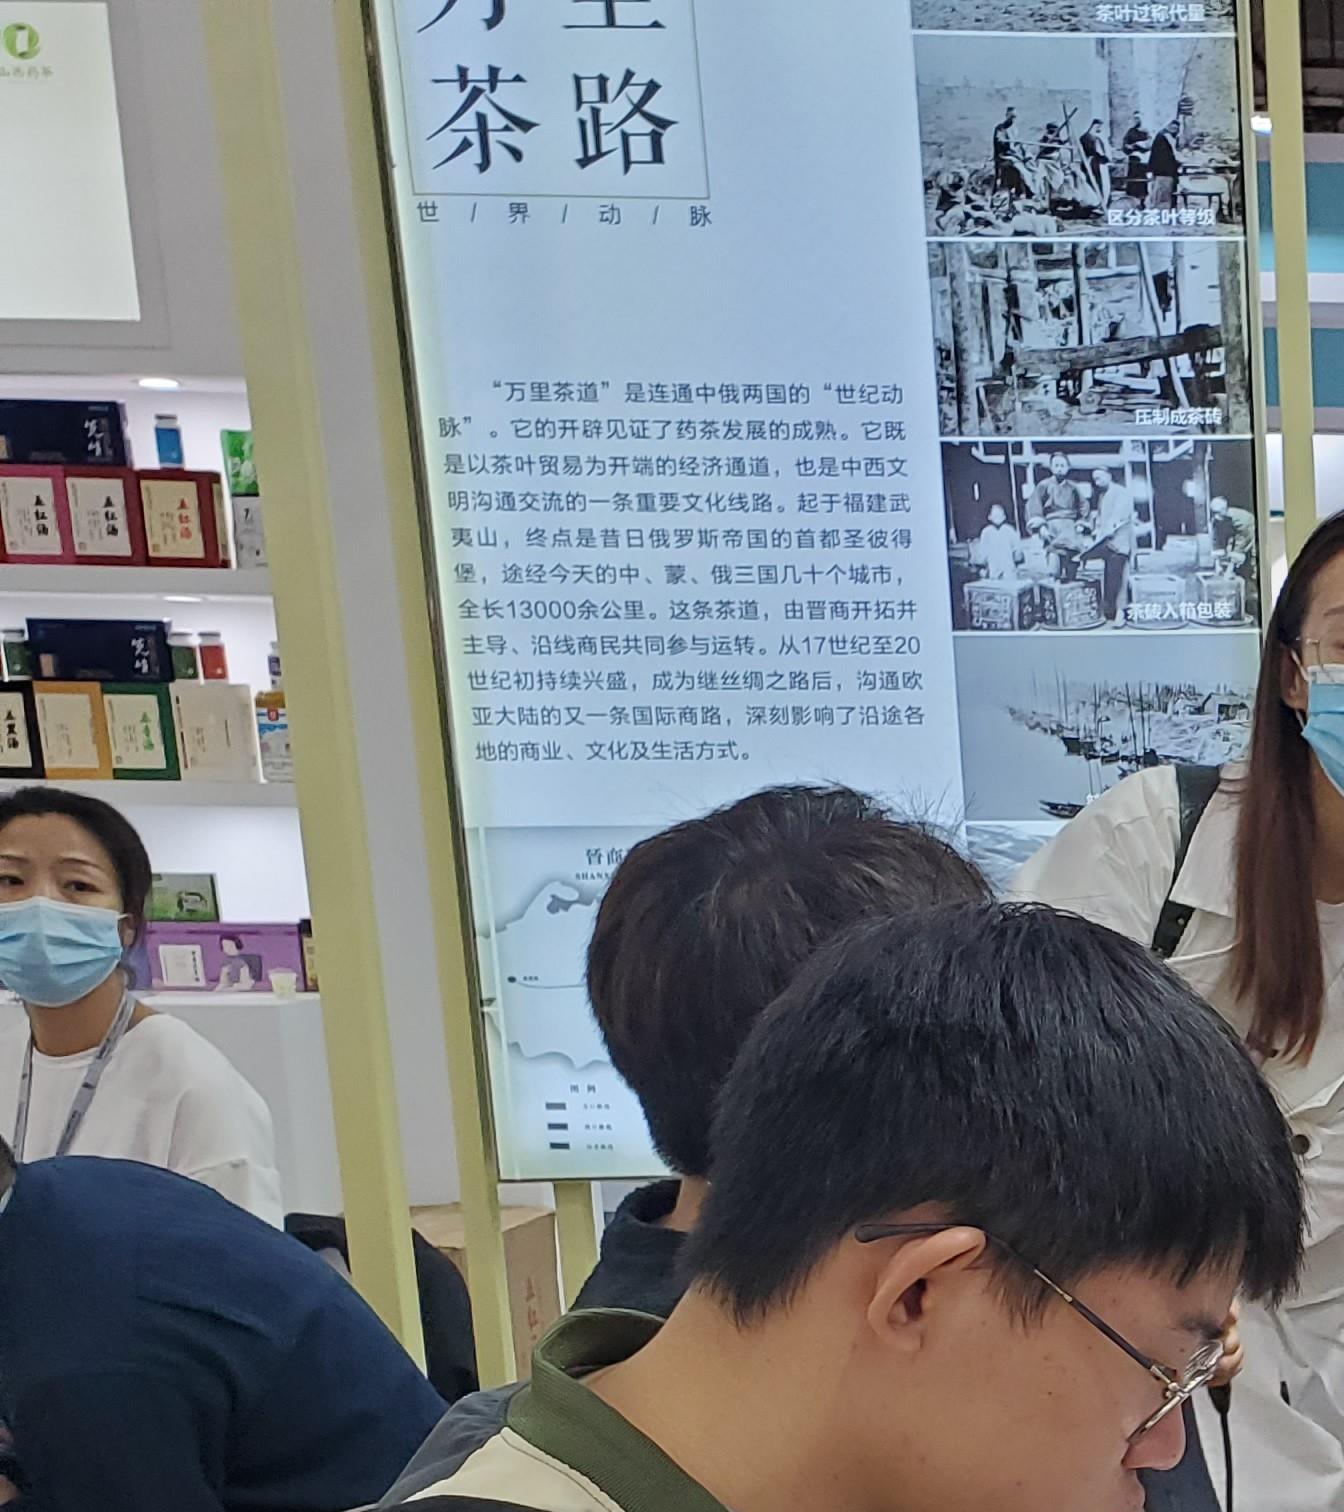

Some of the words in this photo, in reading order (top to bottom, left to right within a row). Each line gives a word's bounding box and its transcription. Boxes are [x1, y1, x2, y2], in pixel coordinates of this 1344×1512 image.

[425, 64, 679, 175] 茶路
[1108, 208, 1216, 226] 区分茶叶等级
[1135, 407, 1222, 425] 压制成茶砖
[475, 741, 754, 763] 地的商业、文化及生活方式。
[586, 848, 625, 866] 晋商
